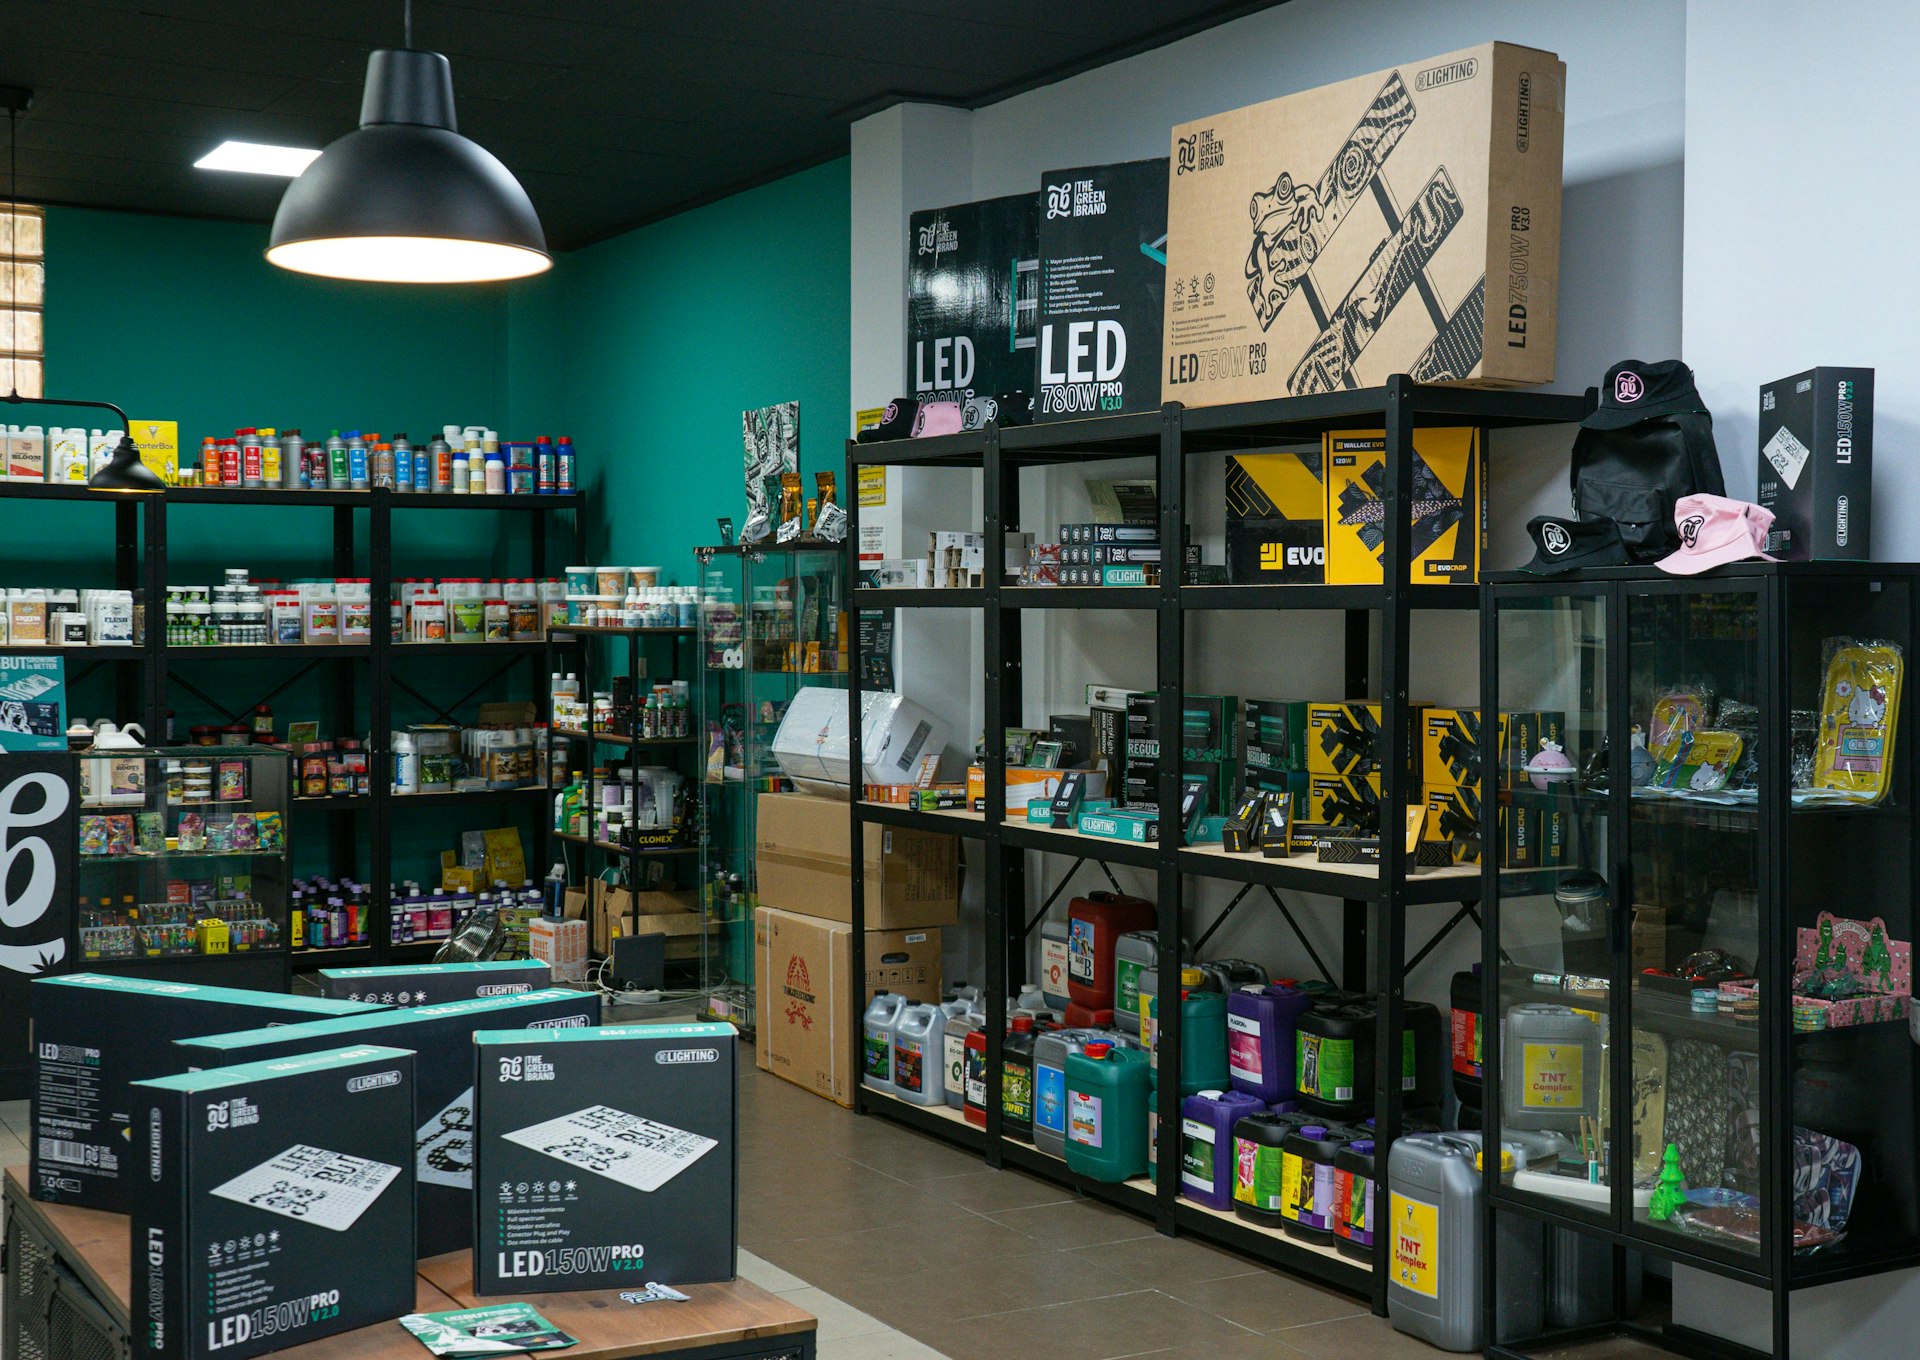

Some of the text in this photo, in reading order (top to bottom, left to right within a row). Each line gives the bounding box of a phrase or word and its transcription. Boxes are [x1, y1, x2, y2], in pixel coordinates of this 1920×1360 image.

[1426, 60, 1474, 87] LIGHTING
[1518, 76, 1530, 137] LIGHTING
[1201, 128, 1214, 144] THE
[1201, 141, 1224, 157] GREEN
[1200, 156, 1224, 171] BRAND
[1076, 180, 1093, 192] THE
[1076, 190, 1106, 204] GREEN
[1076, 202, 1107, 217] BRAND
[1511, 206, 1521, 231] PRO
[1521, 207, 1530, 232] V3.0
[1041, 319, 1127, 385] LED
[1249, 342, 1267, 360] PRO
[916, 336, 975, 391] LED
[1249, 359, 1267, 375] V3.0
[1041, 382, 1122, 413] 780W PRO
[1838, 381, 1847, 400] PRO
[1101, 396, 1122, 411] V3.0
[1438, 563, 1467, 572] EVOCROP
[1, 657, 26, 670] BUT
[1089, 819, 1114, 832] LIGHTING
[639, 835, 673, 844] CLONEX
[1084, 960, 1092, 977] B
[487, 986, 528, 996] LIGHTING
[1122, 983, 1138, 992] Bloom
[85, 1048, 100, 1058] PRO
[527, 1055, 543, 1063] THE
[667, 1050, 714, 1063] LIGHTING
[527, 1063, 554, 1072] GREEN
[356, 1073, 398, 1090] LIGHTING
[527, 1072, 555, 1081] BRAND
[1539, 1073, 1567, 1083] TNT
[1533, 1083, 1573, 1092] Complex
[232, 1097, 248, 1107] THE
[1073, 1098, 1096, 1111] Terra Flores
[231, 1105, 258, 1118] GREEN
[231, 1114, 259, 1128] BRAND
[151, 1122, 161, 1177] LIGHTING
[1292, 1190, 1299, 1200] A
[1343, 1204, 1351, 1216] B
[612, 1244, 644, 1259] PRO
[1399, 1236, 1420, 1256] TNT
[1395, 1246, 1427, 1271] Complex
[310, 1289, 339, 1310] PRO
